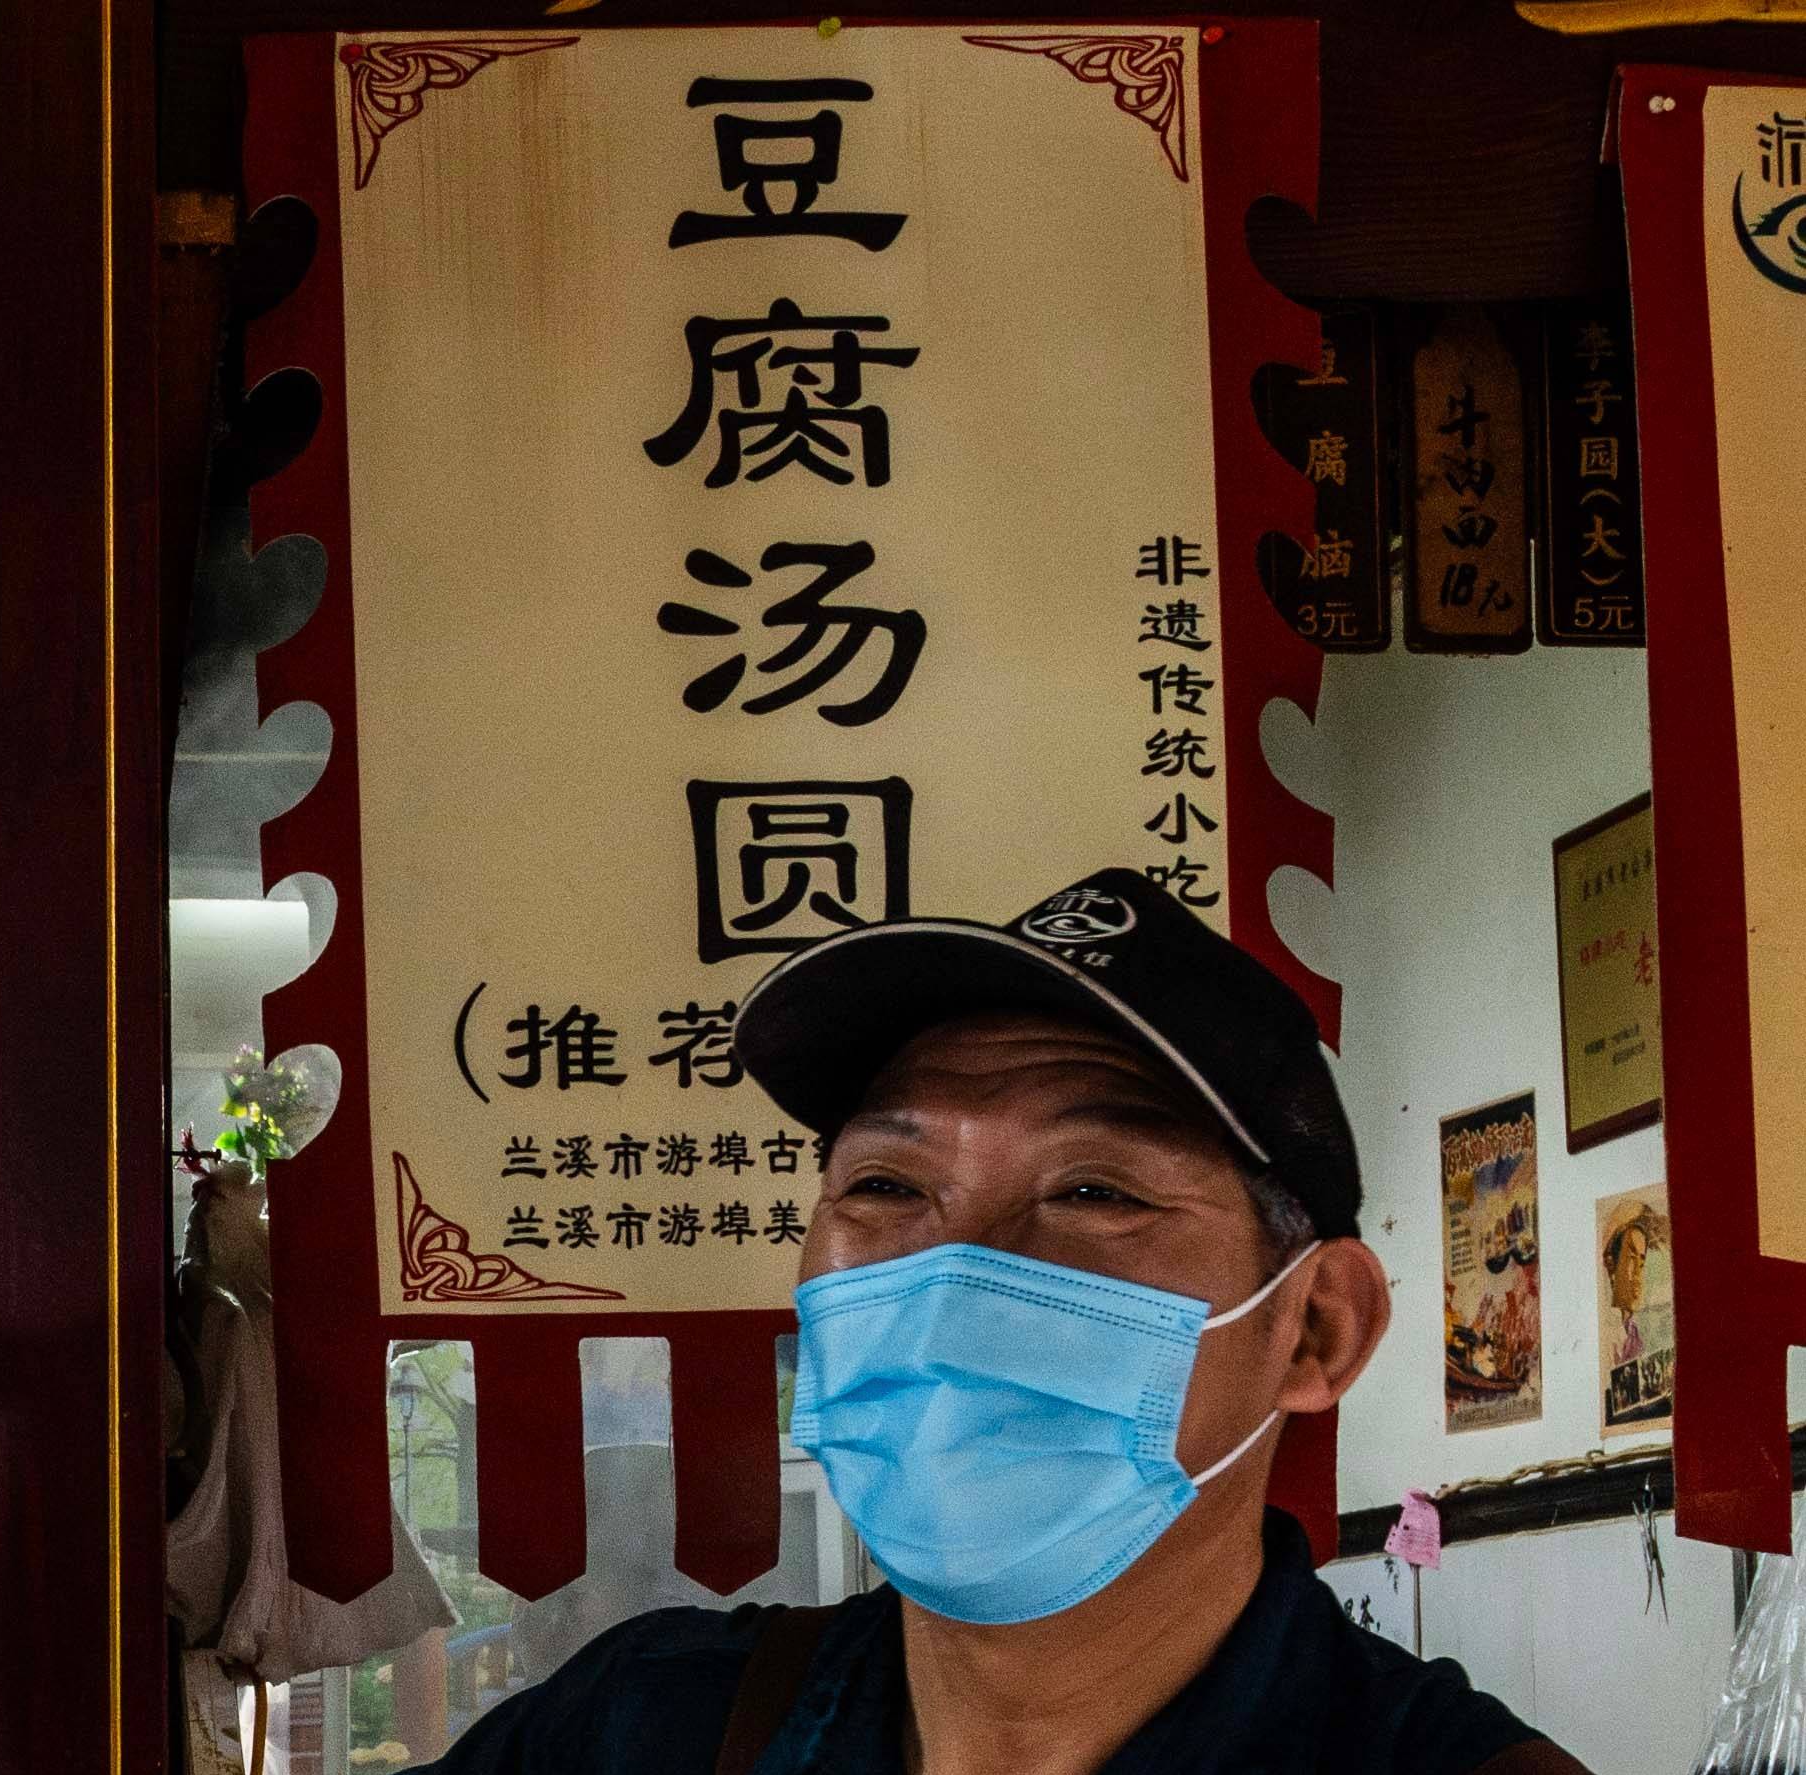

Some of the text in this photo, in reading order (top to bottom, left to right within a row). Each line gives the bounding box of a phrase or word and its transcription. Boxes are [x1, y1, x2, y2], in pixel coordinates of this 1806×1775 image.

[642, 77, 928, 964] 豆腐汤圆
[1296, 601, 1359, 638] 3元
[1573, 596, 1636, 630] 5元
[1134, 535, 1221, 908] 非遗传统小吃
[501, 1128, 829, 1180] 兰溪市游埠古
